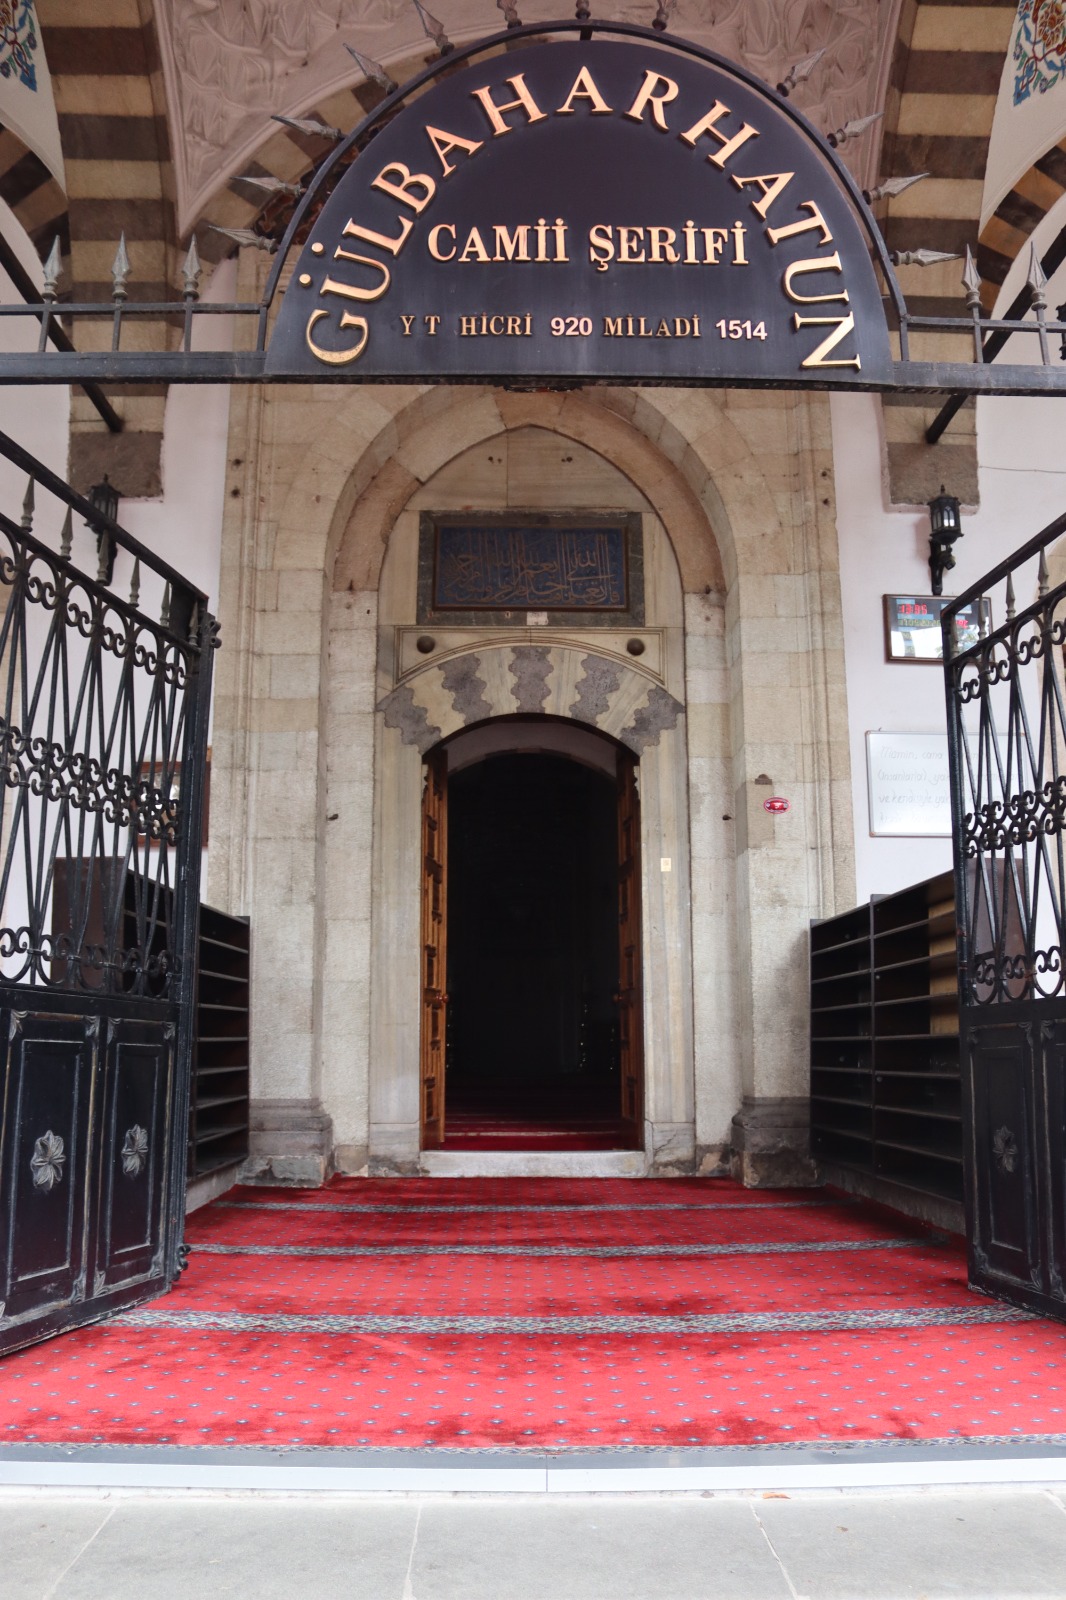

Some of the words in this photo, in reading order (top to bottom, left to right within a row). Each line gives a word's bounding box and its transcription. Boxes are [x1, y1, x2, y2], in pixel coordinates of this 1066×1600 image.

[427, 217, 570, 263] CAMİİ
[588, 219, 750, 272] ŞERİFİ
[400, 315, 415, 335] Y
[424, 315, 441, 335] T
[459, 312, 533, 336] HİCRİ
[550, 316, 593, 336] 920
[603, 314, 701, 337] MİLADİ
[715, 319, 768, 340] 1514
